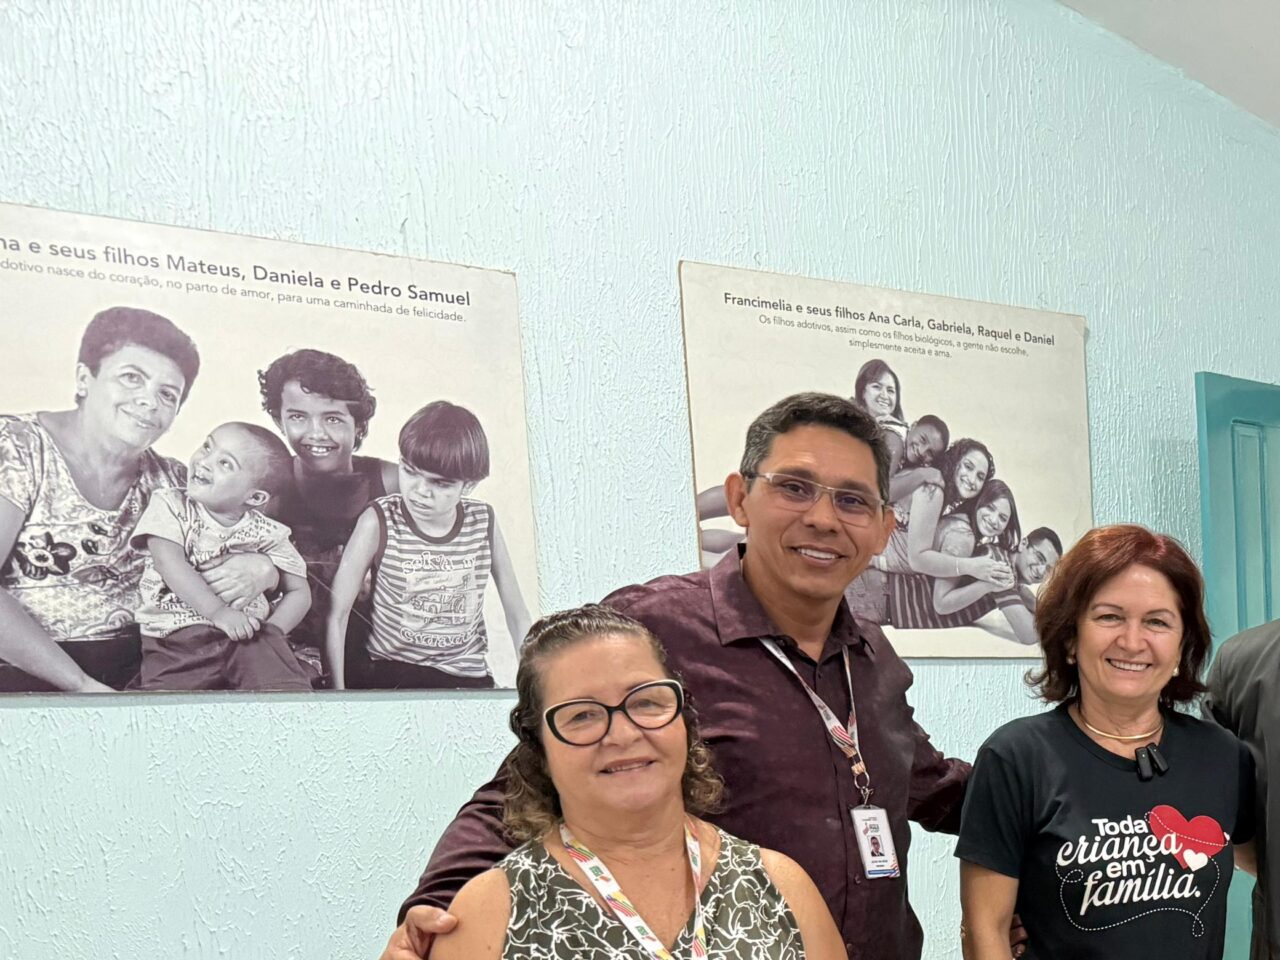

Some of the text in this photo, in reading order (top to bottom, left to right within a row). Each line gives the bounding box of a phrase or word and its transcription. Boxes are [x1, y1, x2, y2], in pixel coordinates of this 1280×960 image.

[28, 241, 42, 254] e
[49, 243, 97, 260] seus
[102, 246, 160, 269] filhos
[166, 254, 246, 281] Mateus,
[253, 265, 324, 288] Daniela
[330, 279, 341, 290] e
[347, 277, 402, 298] Pedro
[408, 284, 471, 306] Samuel
[47, 264, 85, 278] nasce
[88, 269, 106, 281] do
[109, 271, 163, 288] coração,
[166, 280, 182, 289] no
[186, 281, 218, 294] parto
[221, 284, 237, 296] de
[240, 289, 274, 302] amor,
[277, 292, 303, 304] para
[306, 297, 331, 307] uma
[333, 298, 393, 314] caminhada
[395, 304, 410, 316] de
[413, 306, 467, 323] felicidade.
[724, 292, 1055, 346] Francimelia e seus filhos Ana Carla, Gabriela, Raquel e Daniel
[759, 314, 772, 325] Os
[773, 315, 795, 328] filhos
[796, 320, 834, 333] adotivos,
[835, 325, 857, 335] assim
[858, 329, 881, 338] como
[882, 331, 892, 340] os
[893, 330, 913, 343] filhos
[914, 334, 955, 348] biológicos,
[962, 342, 984, 352] gente
[985, 344, 999, 353] não
[1000, 347, 1029, 357] escolhe,
[849, 338, 953, 359] simplesmente aceita e ama.
[1091, 814, 1148, 837] Toda
[1056, 832, 1183, 867] criança
[1106, 859, 1145, 878] em
[1079, 863, 1201, 916] família.
